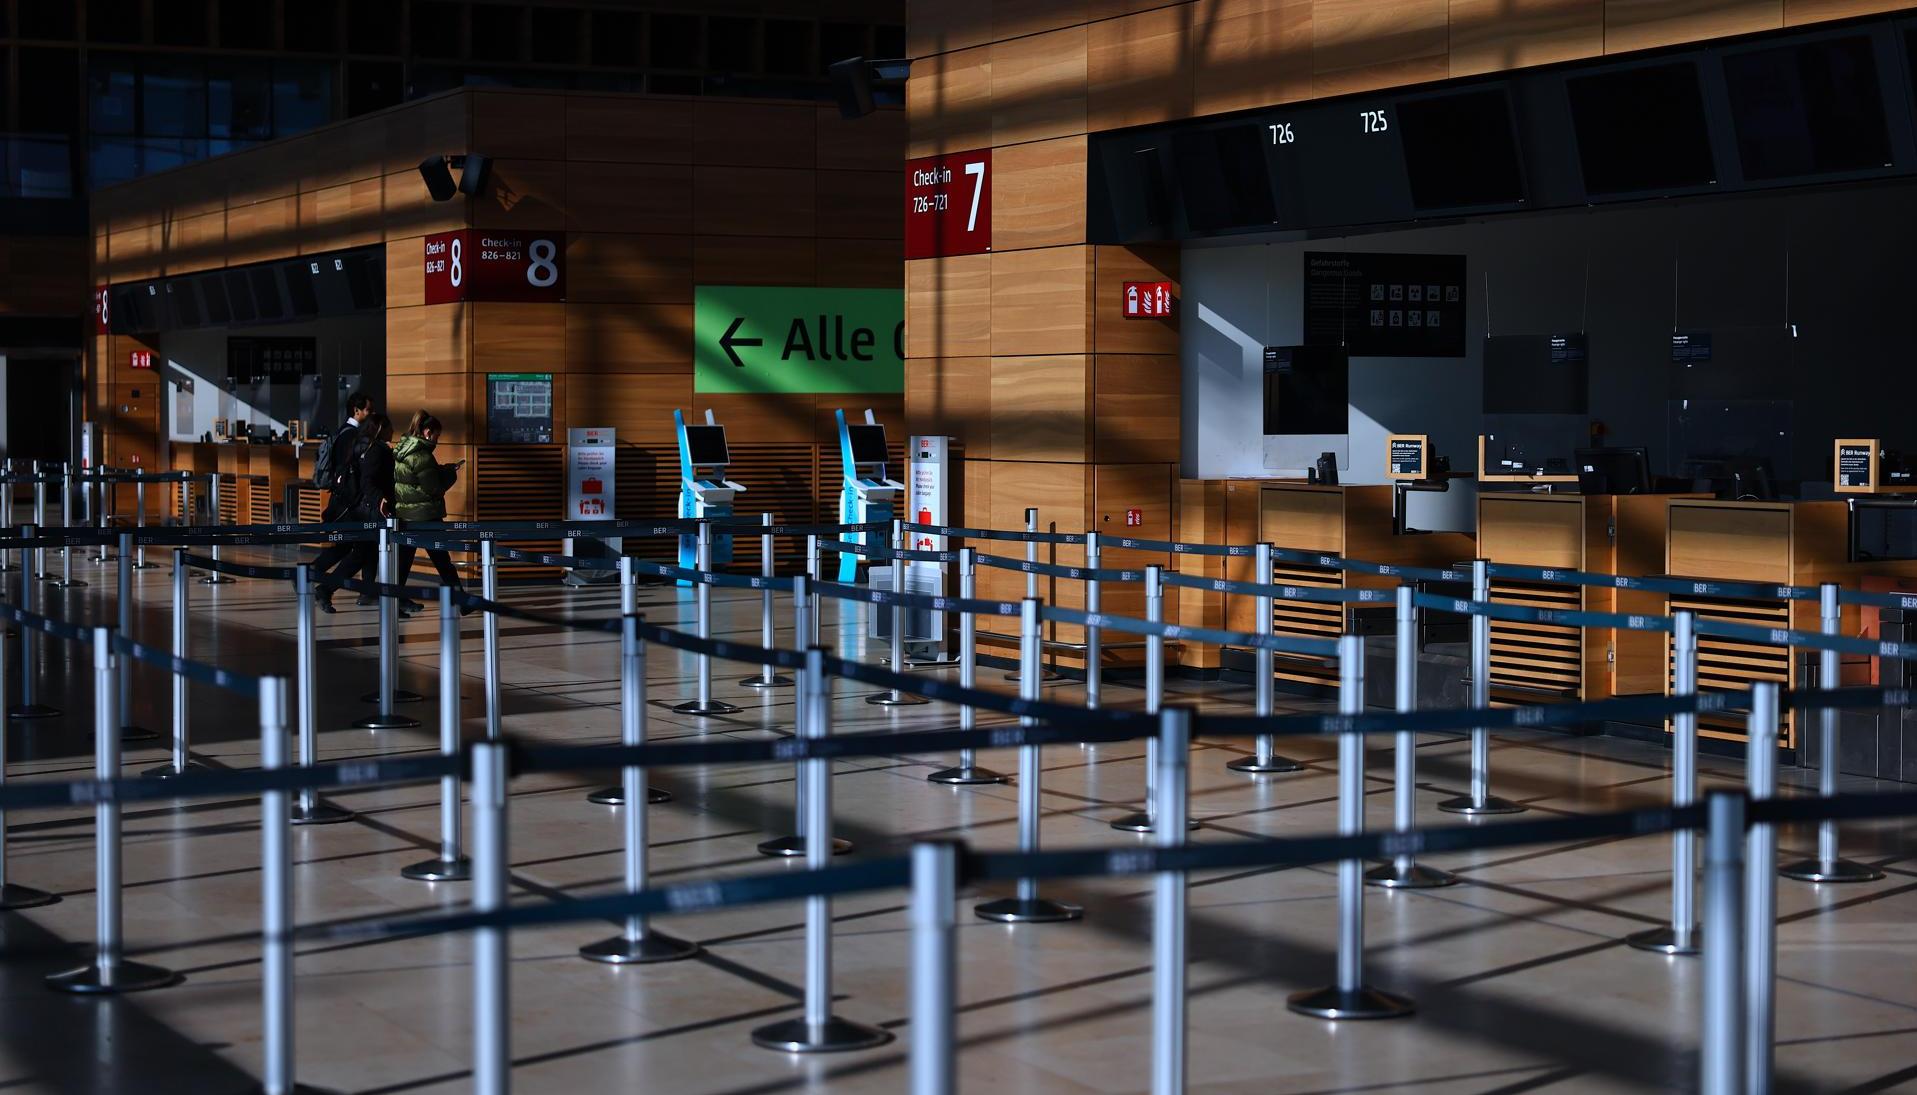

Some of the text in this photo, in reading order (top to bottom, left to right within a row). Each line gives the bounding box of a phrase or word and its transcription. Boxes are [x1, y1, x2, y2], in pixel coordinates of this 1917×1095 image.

[1360, 110, 1388, 134] 725
[1268, 122, 1295, 145] 726
[913, 165, 952, 187] Check-in
[965, 162, 985, 232] 7
[426, 241, 446, 255] Check-in
[481, 238, 522, 247] Check-in
[450, 238, 462, 288] 8
[526, 239, 559, 287] 8
[102, 290, 108, 325] 8
[781, 314, 875, 362] Alle
[1380, 565, 1390, 574] BER
[1442, 571, 1452, 580] BER
[1543, 570, 1554, 580] BER
[1214, 580, 1226, 590] BER
[1616, 577, 1628, 587] BER
[1284, 588, 1296, 597] BER
[1694, 584, 1707, 593] BER
[1778, 587, 1791, 597] BER
[1360, 590, 1373, 600] BER
[1455, 600, 1468, 611] BER
[1902, 597, 1917, 608] BER
[1538, 609, 1552, 621] BER
[1629, 616, 1644, 628] BER
[1772, 630, 1789, 642] BER
[1880, 643, 1899, 655] BER
